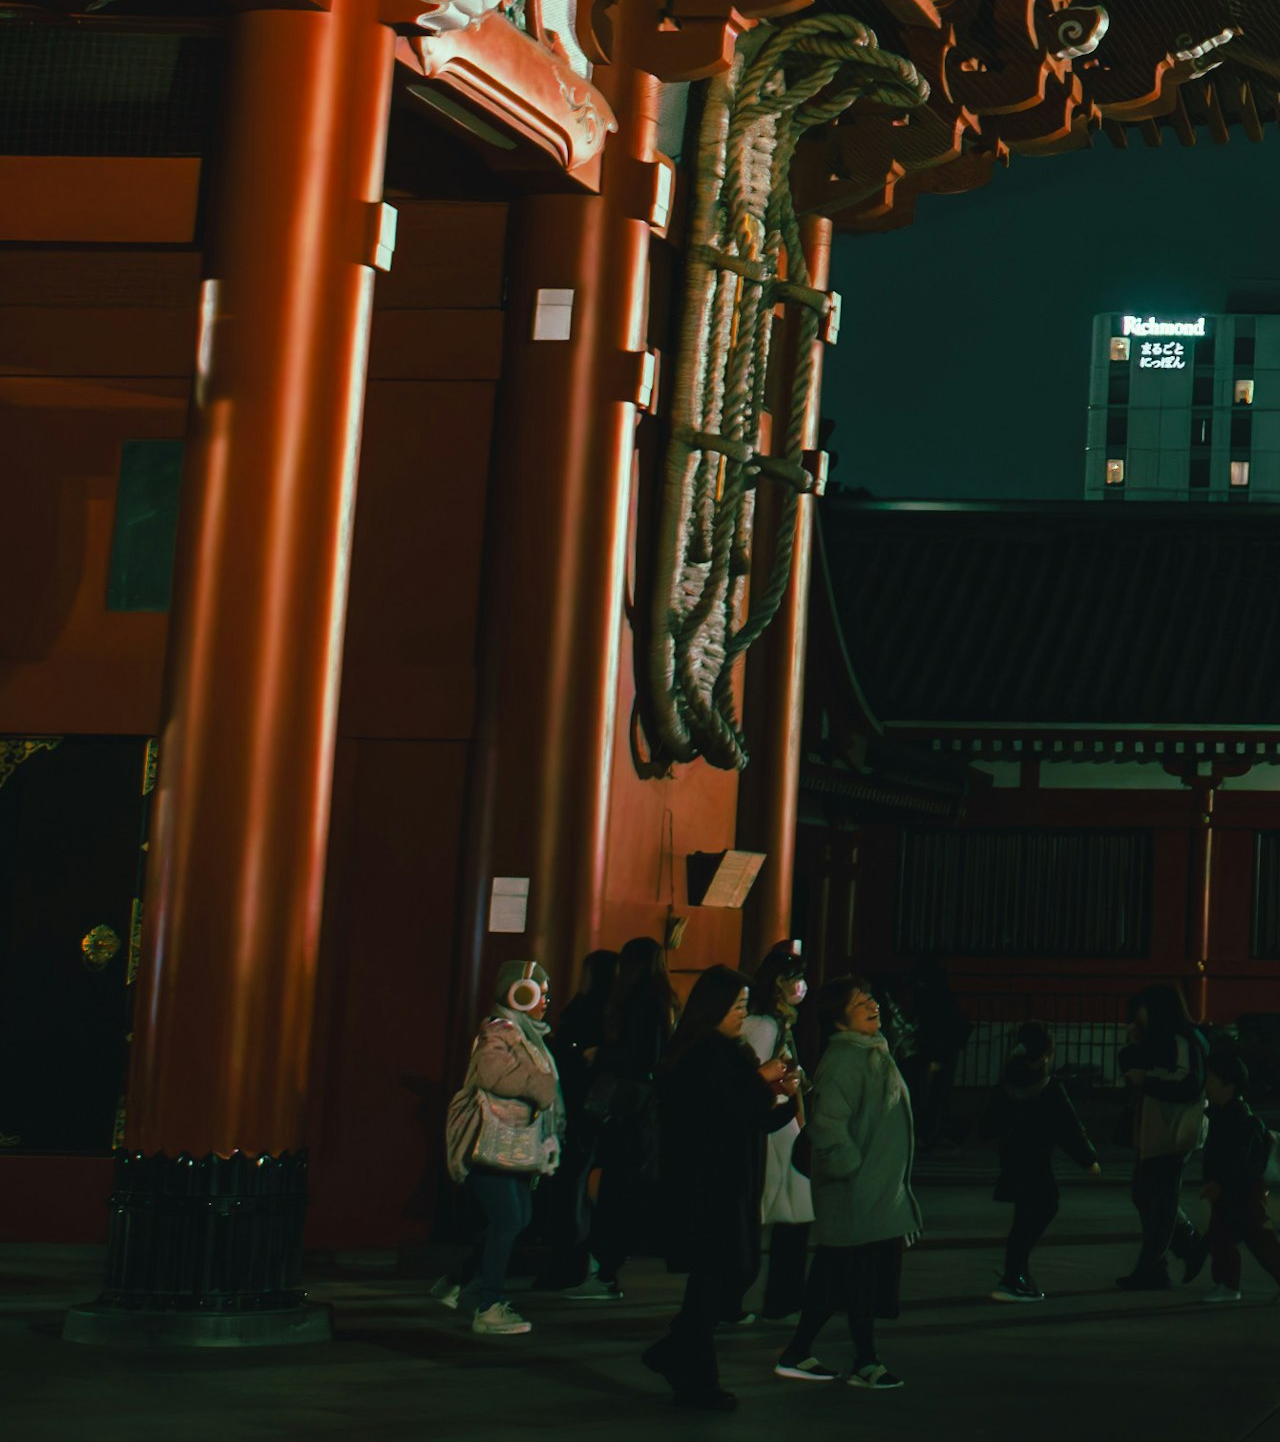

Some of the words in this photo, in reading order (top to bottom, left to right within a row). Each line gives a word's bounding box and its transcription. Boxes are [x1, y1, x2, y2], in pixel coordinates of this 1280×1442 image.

[1123, 316, 1205, 337] Richmond
[1141, 341, 1184, 355] まるごと
[1140, 356, 1185, 369] にっぽん
